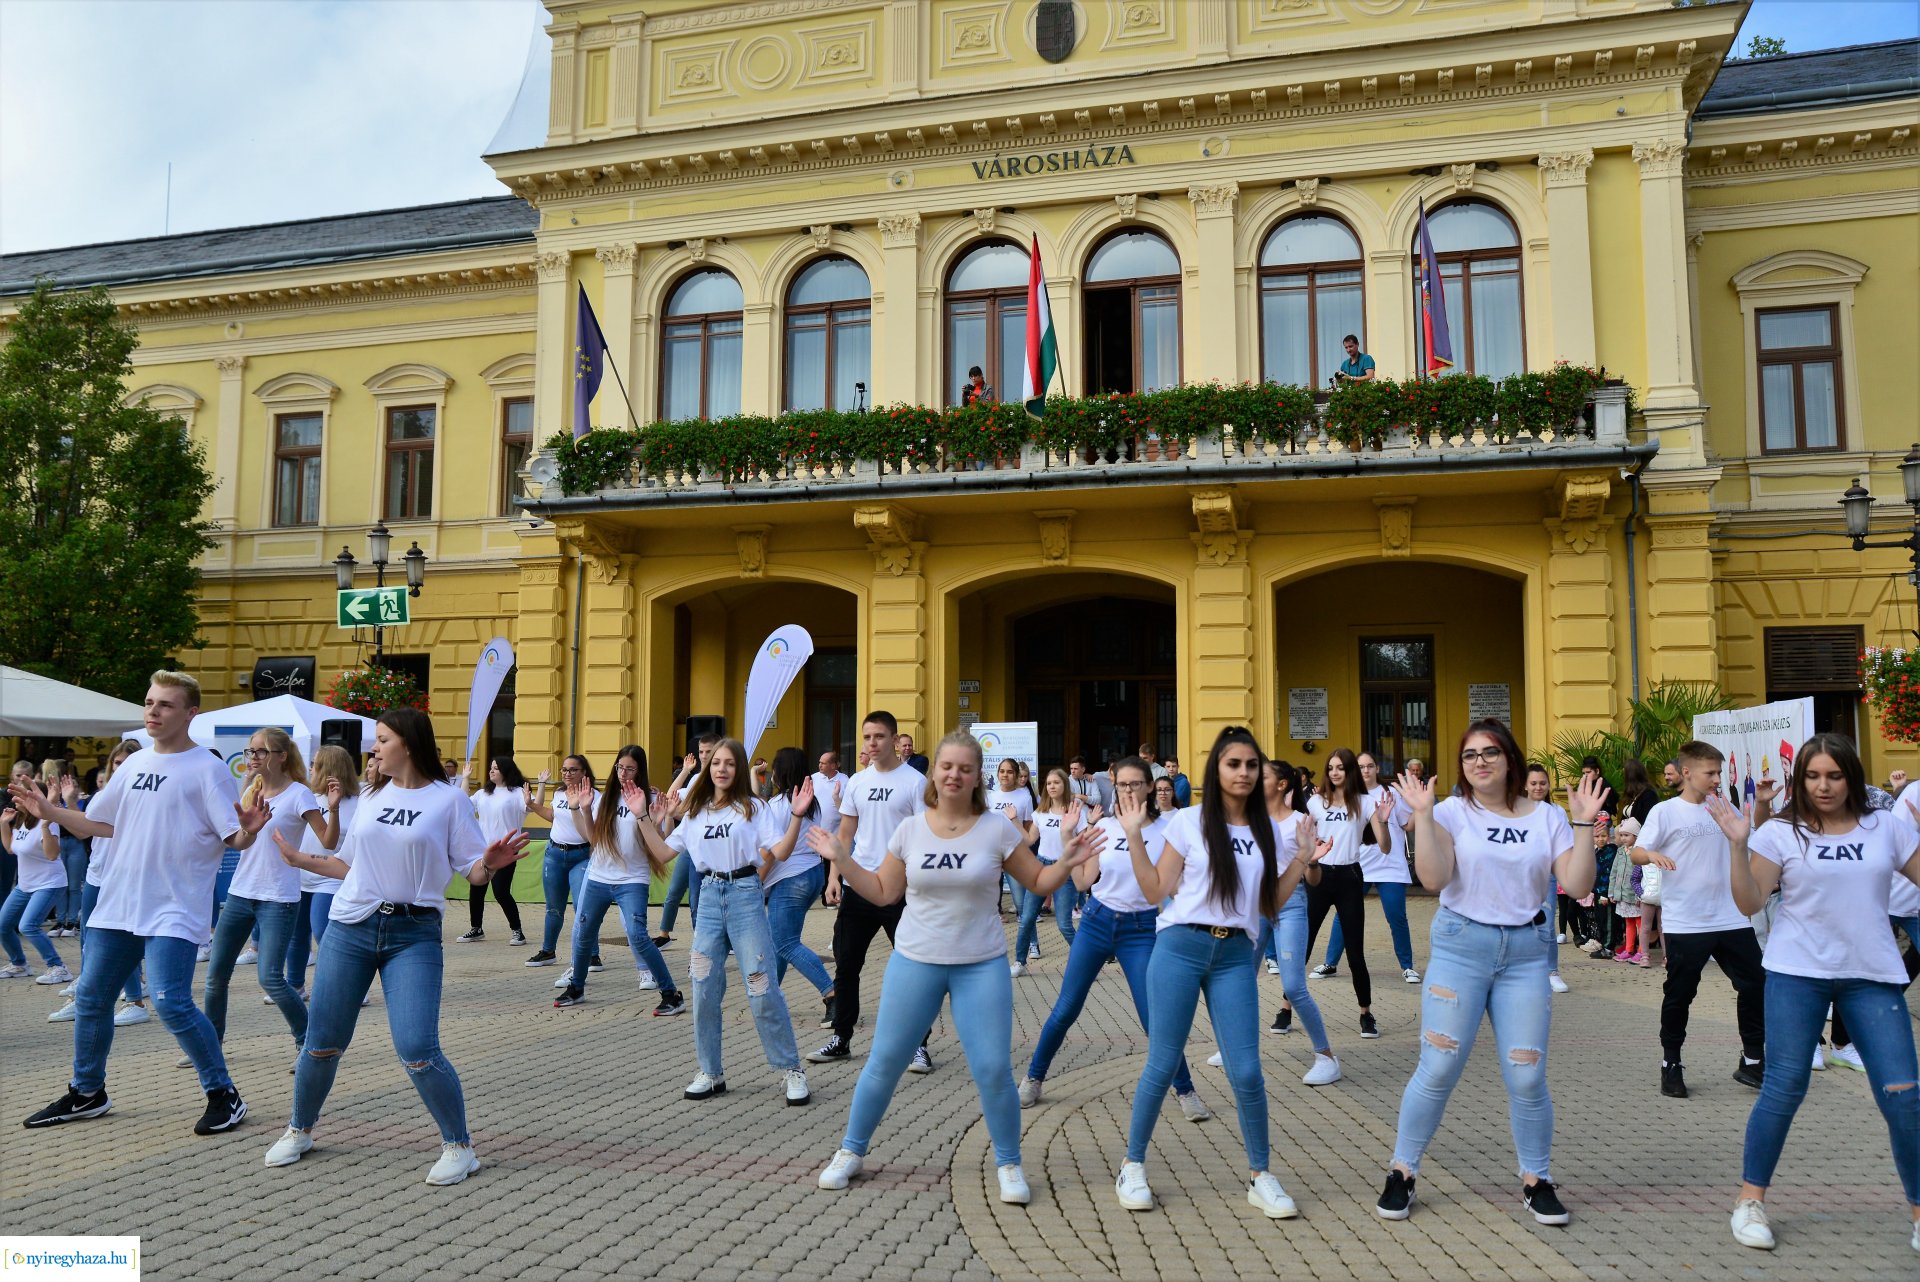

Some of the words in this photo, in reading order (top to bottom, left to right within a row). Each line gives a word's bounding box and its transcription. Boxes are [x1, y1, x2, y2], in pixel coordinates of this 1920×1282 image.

[972, 144, 1135, 179] VÁROSHÁZA
[131, 773, 168, 792] ZAY
[868, 788, 894, 802] ZAY
[557, 800, 568, 810] ZA
[616, 805, 630, 818] AY
[377, 808, 422, 827] ZAY
[1046, 818, 1061, 828] ZA
[16, 830, 29, 841] ZAY
[704, 822, 733, 840] ZAY
[1487, 828, 1529, 844] ZAY
[1231, 838, 1254, 855] AY
[1815, 843, 1864, 861] ZAY
[921, 853, 968, 870] ZAY
